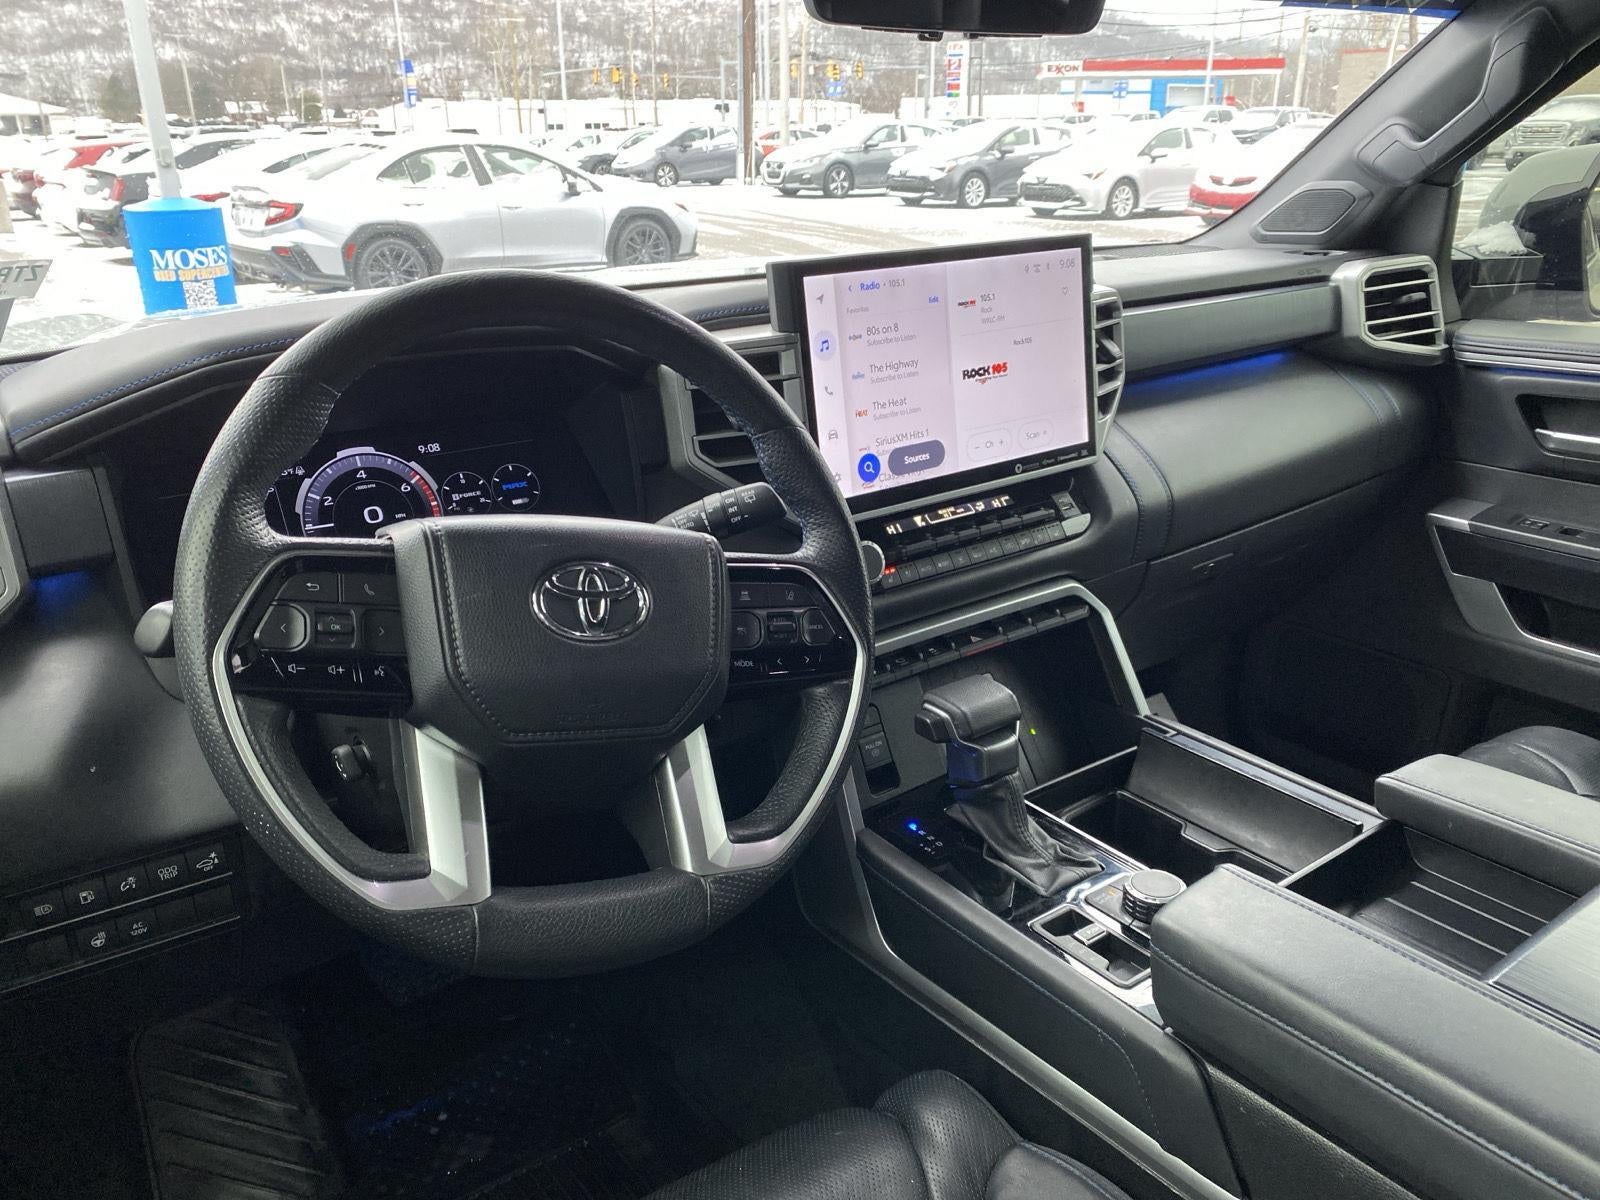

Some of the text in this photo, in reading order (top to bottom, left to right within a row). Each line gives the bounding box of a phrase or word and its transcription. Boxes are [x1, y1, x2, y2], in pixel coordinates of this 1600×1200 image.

[1048, 63, 1079, 74] EXXON
[150, 246, 228, 270] MOSES
[860, 278, 905, 290] Radio 105.1
[980, 294, 996, 302] 105.1
[866, 326, 880, 336] 80s
[894, 323, 899, 332] 8
[870, 359, 919, 373] The Highway
[962, 366, 990, 380] ROCK
[992, 362, 1008, 374] 105
[872, 397, 907, 410] The Heat
[876, 432, 908, 447] SiriusXM
[910, 430, 924, 439] Hits
[1026, 431, 1040, 440] Scan
[418, 443, 440, 454] 9:08
[904, 452, 930, 464] Sources
[357, 470, 367, 478] 4
[401, 482, 411, 492] 6
[323, 496, 334, 506] 2
[364, 506, 383, 523] 0
[886, 523, 902, 535] HI
[158, 865, 177, 875] ODO
[160, 871, 177, 880] TRIP
[133, 921, 143, 929] AC
[130, 927, 147, 935] 120V
